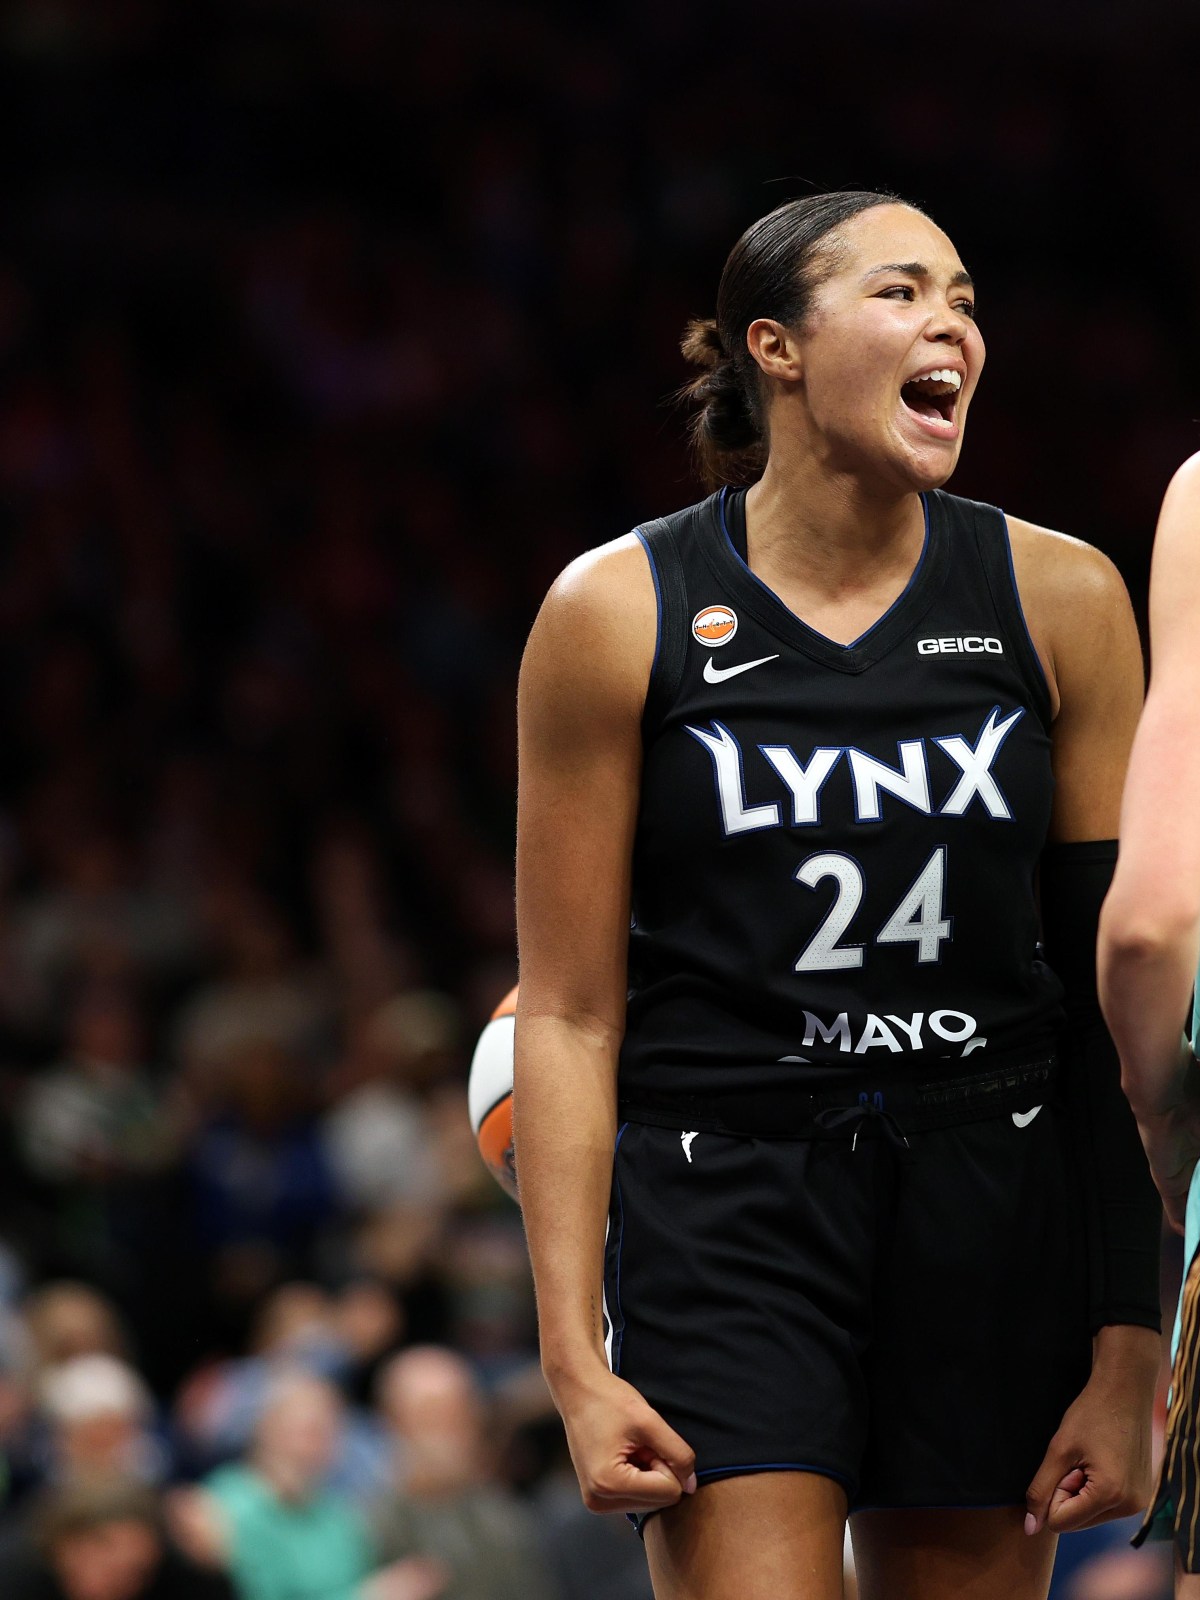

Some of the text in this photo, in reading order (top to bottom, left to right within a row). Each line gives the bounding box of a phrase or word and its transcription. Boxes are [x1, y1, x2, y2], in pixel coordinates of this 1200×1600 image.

[917, 637, 1003, 655] GEICO
[682, 705, 1026, 836] LYNX
[793, 846, 952, 973] 24
[801, 1010, 977, 1054] MAYO
